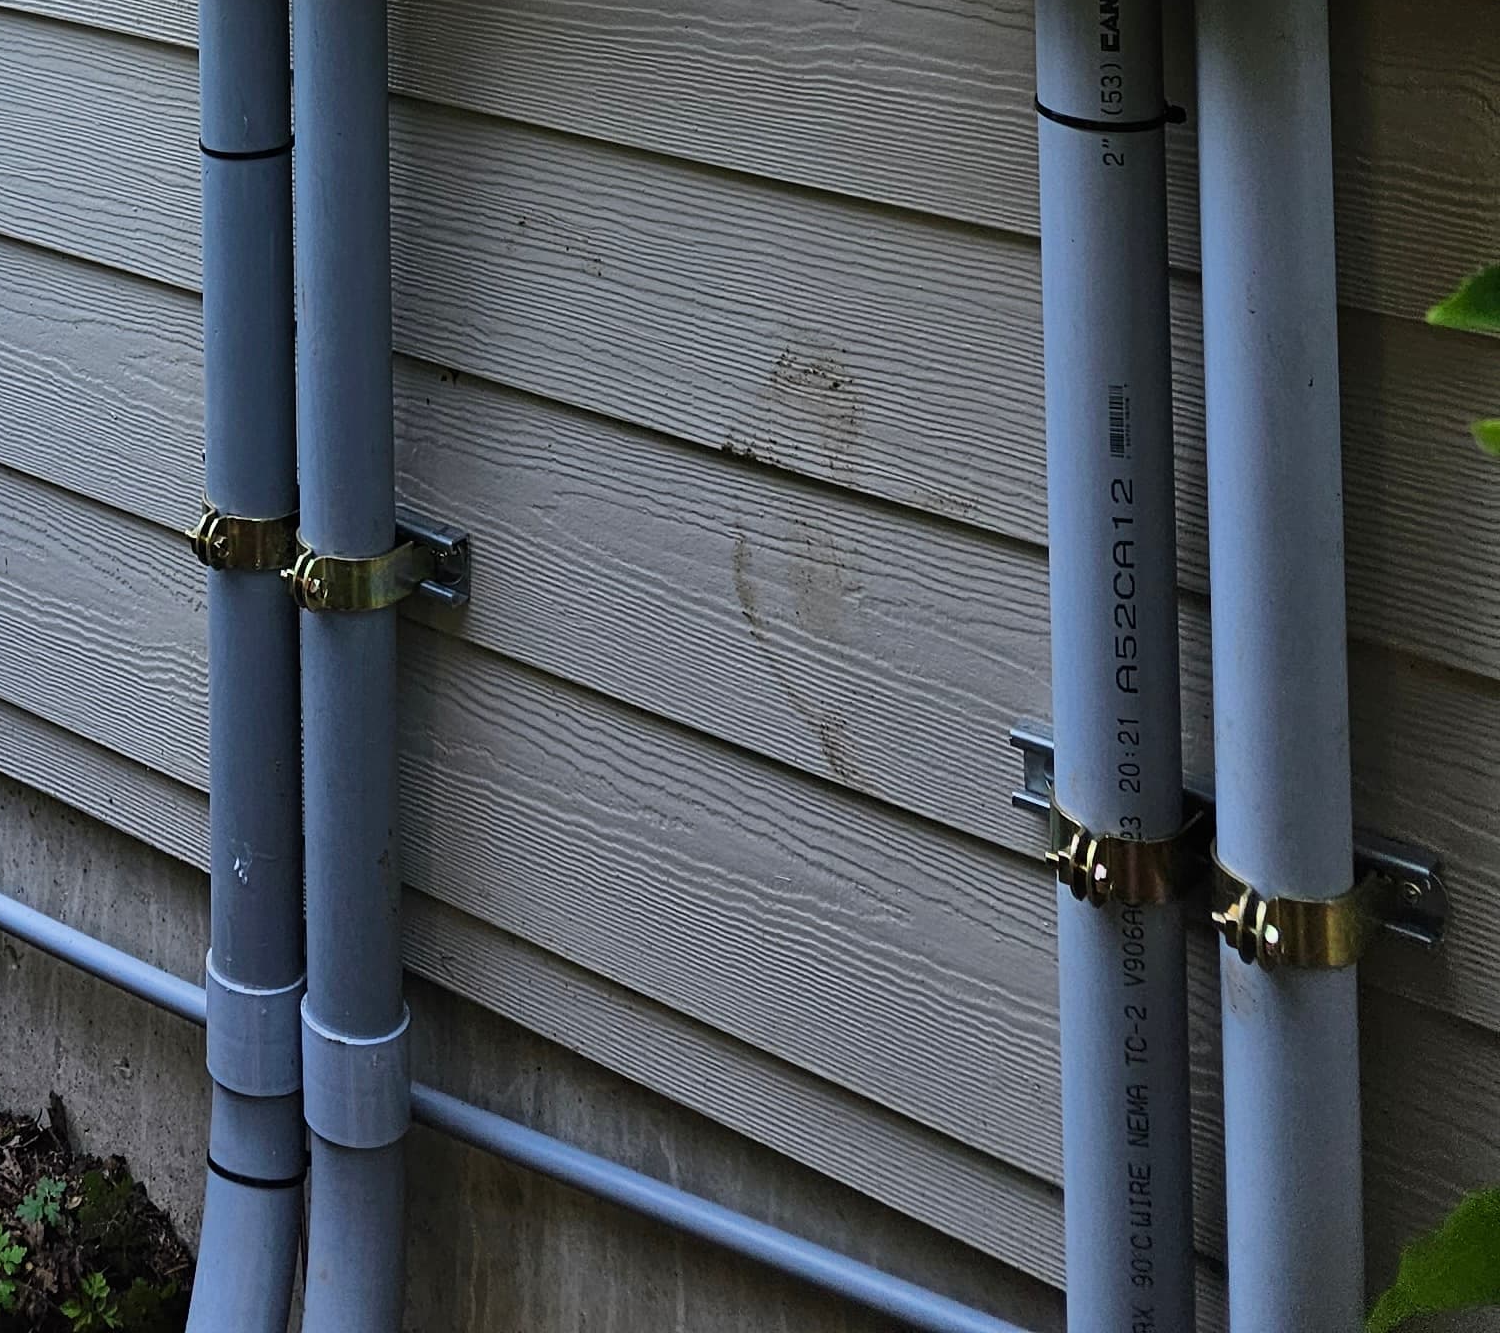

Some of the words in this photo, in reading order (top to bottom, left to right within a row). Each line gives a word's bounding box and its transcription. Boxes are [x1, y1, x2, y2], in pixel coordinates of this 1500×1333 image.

[1099, 62, 1123, 116] (53)
[1110, 478, 1138, 694] A52CA12
[1116, 716, 1141, 794] 20:21
[1123, 1004, 1148, 1067] TC-2
[1125, 1084, 1150, 1148] NEMA
[1126, 1162, 1153, 1227] WIRE
